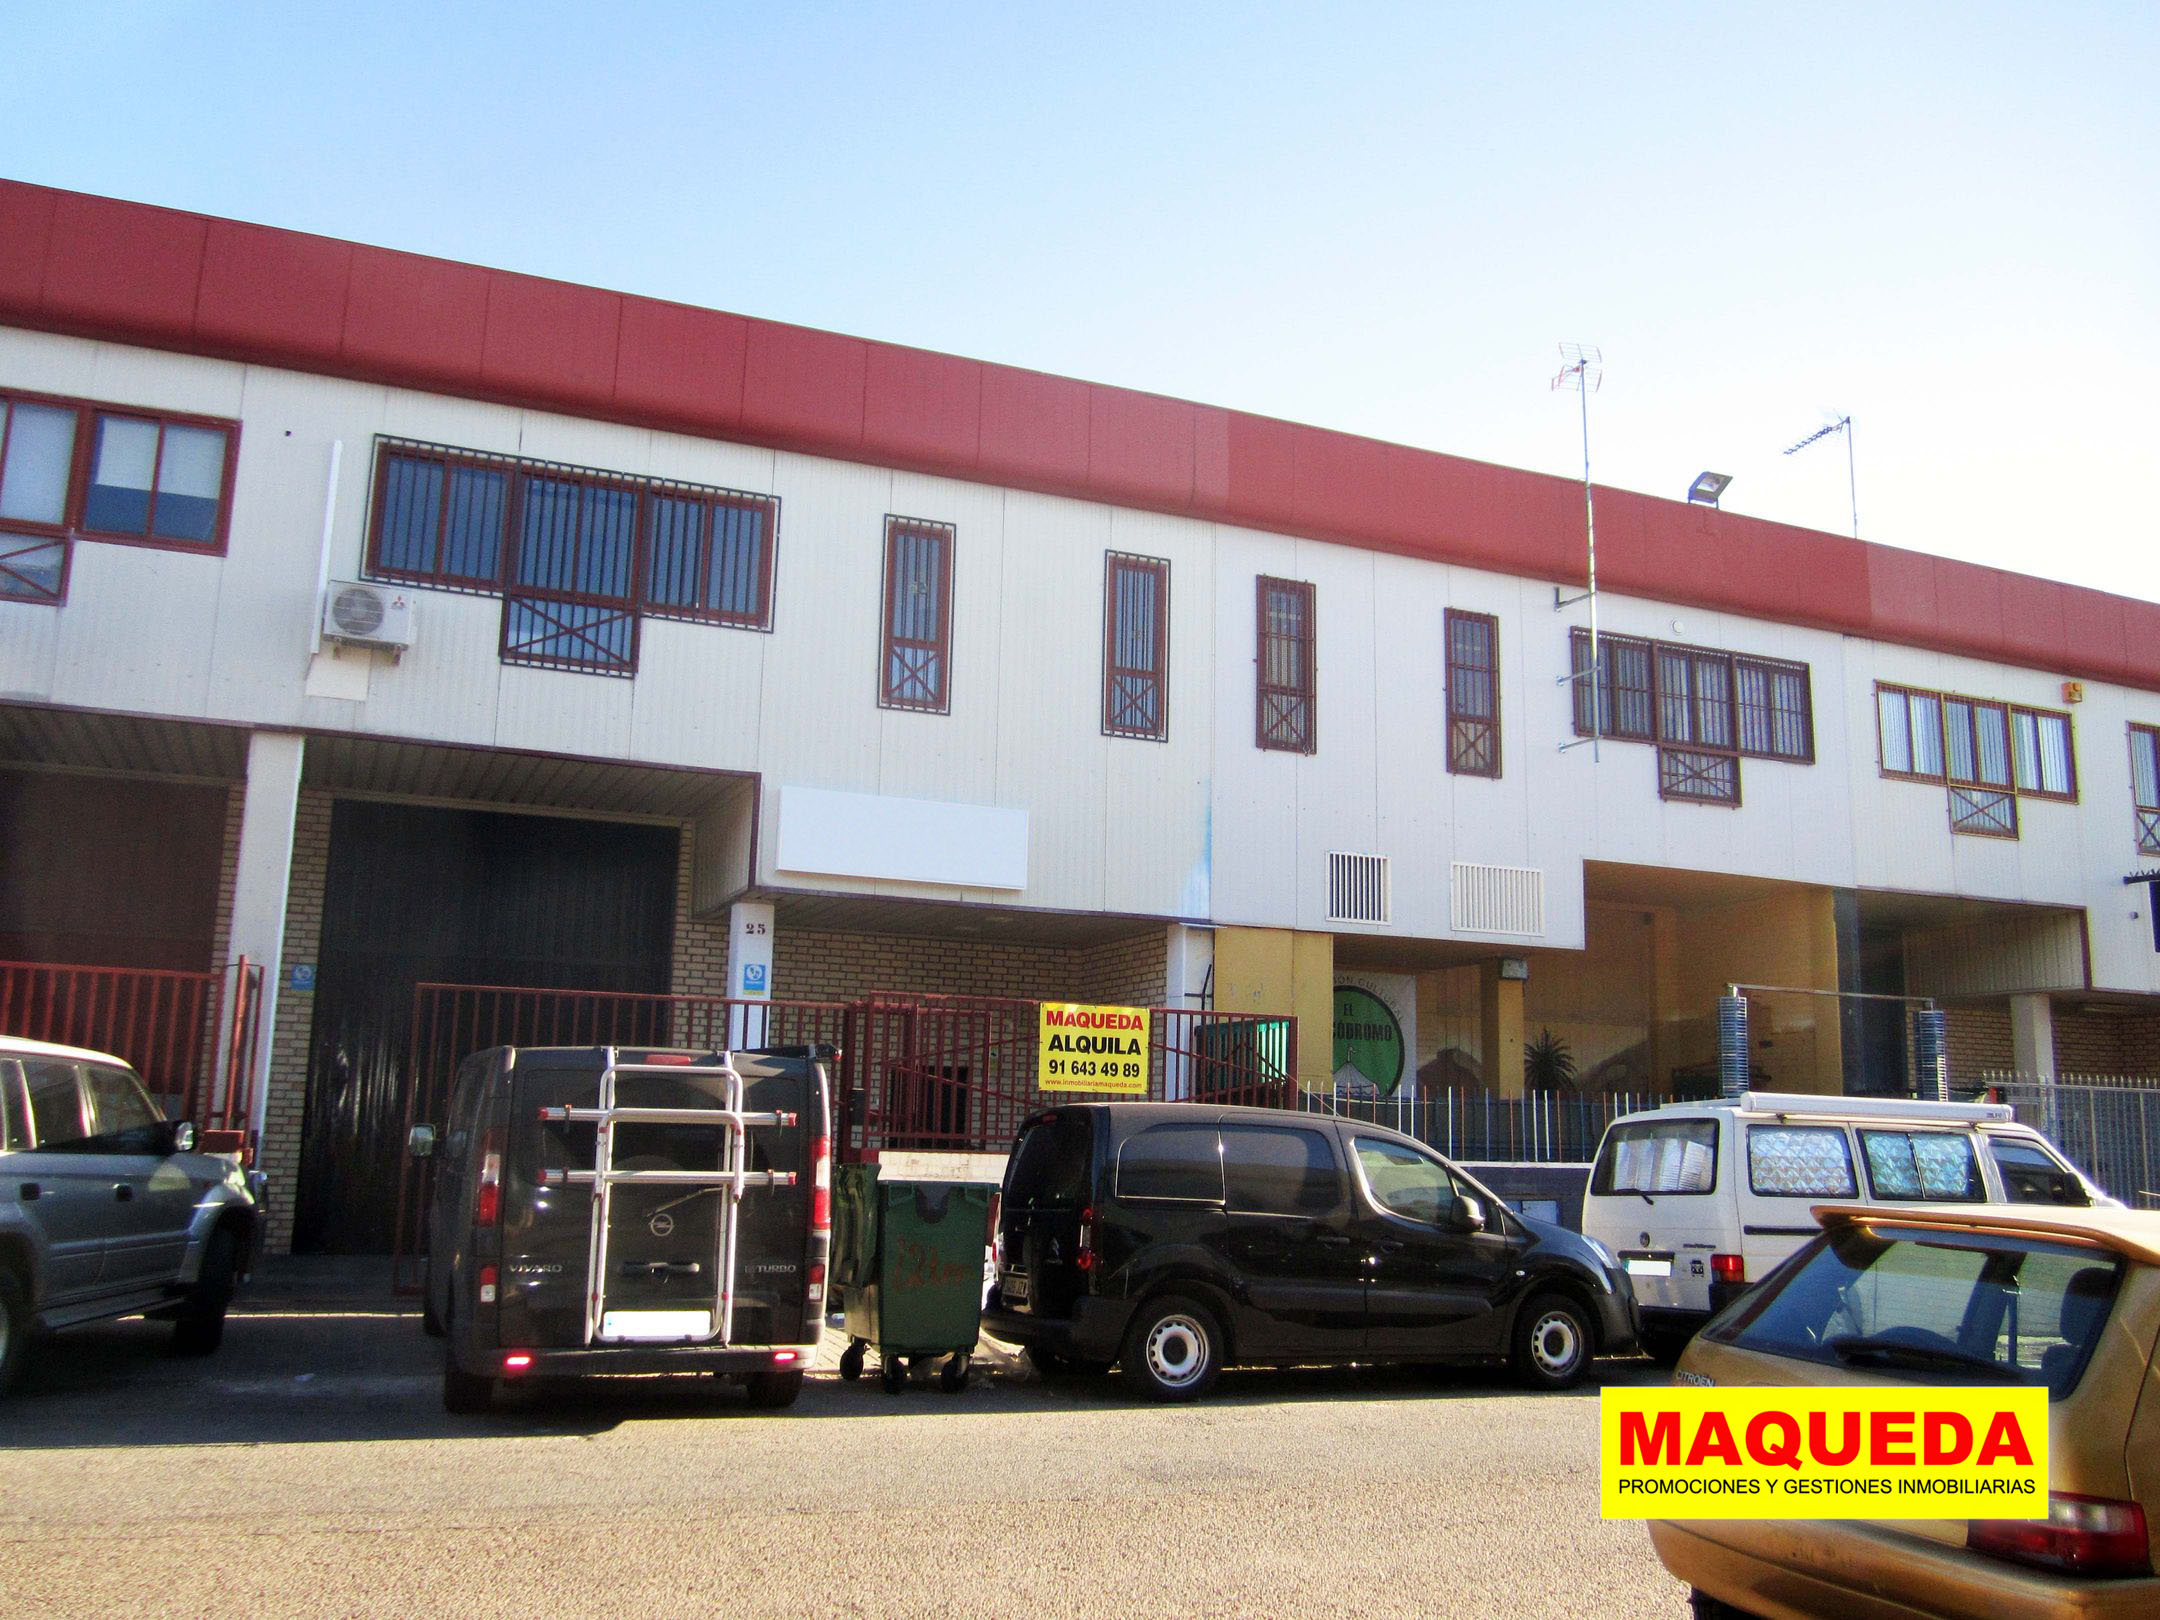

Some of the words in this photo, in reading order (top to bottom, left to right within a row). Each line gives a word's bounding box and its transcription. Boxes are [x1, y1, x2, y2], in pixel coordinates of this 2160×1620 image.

[1343, 1003, 1354, 1017] EL
[1046, 1010, 1144, 1031] MAQUEDA
[1048, 1034, 1142, 1055] ALQUILA
[1049, 1060, 1065, 1074] 91
[1071, 1061, 1096, 1076] 643
[1100, 1062, 1118, 1077] 49
[1123, 1063, 1140, 1078] 89
[1045, 1079, 1142, 1089] www.inmobiliariamaqueda.com
[510, 1264, 562, 1273] VIVARO
